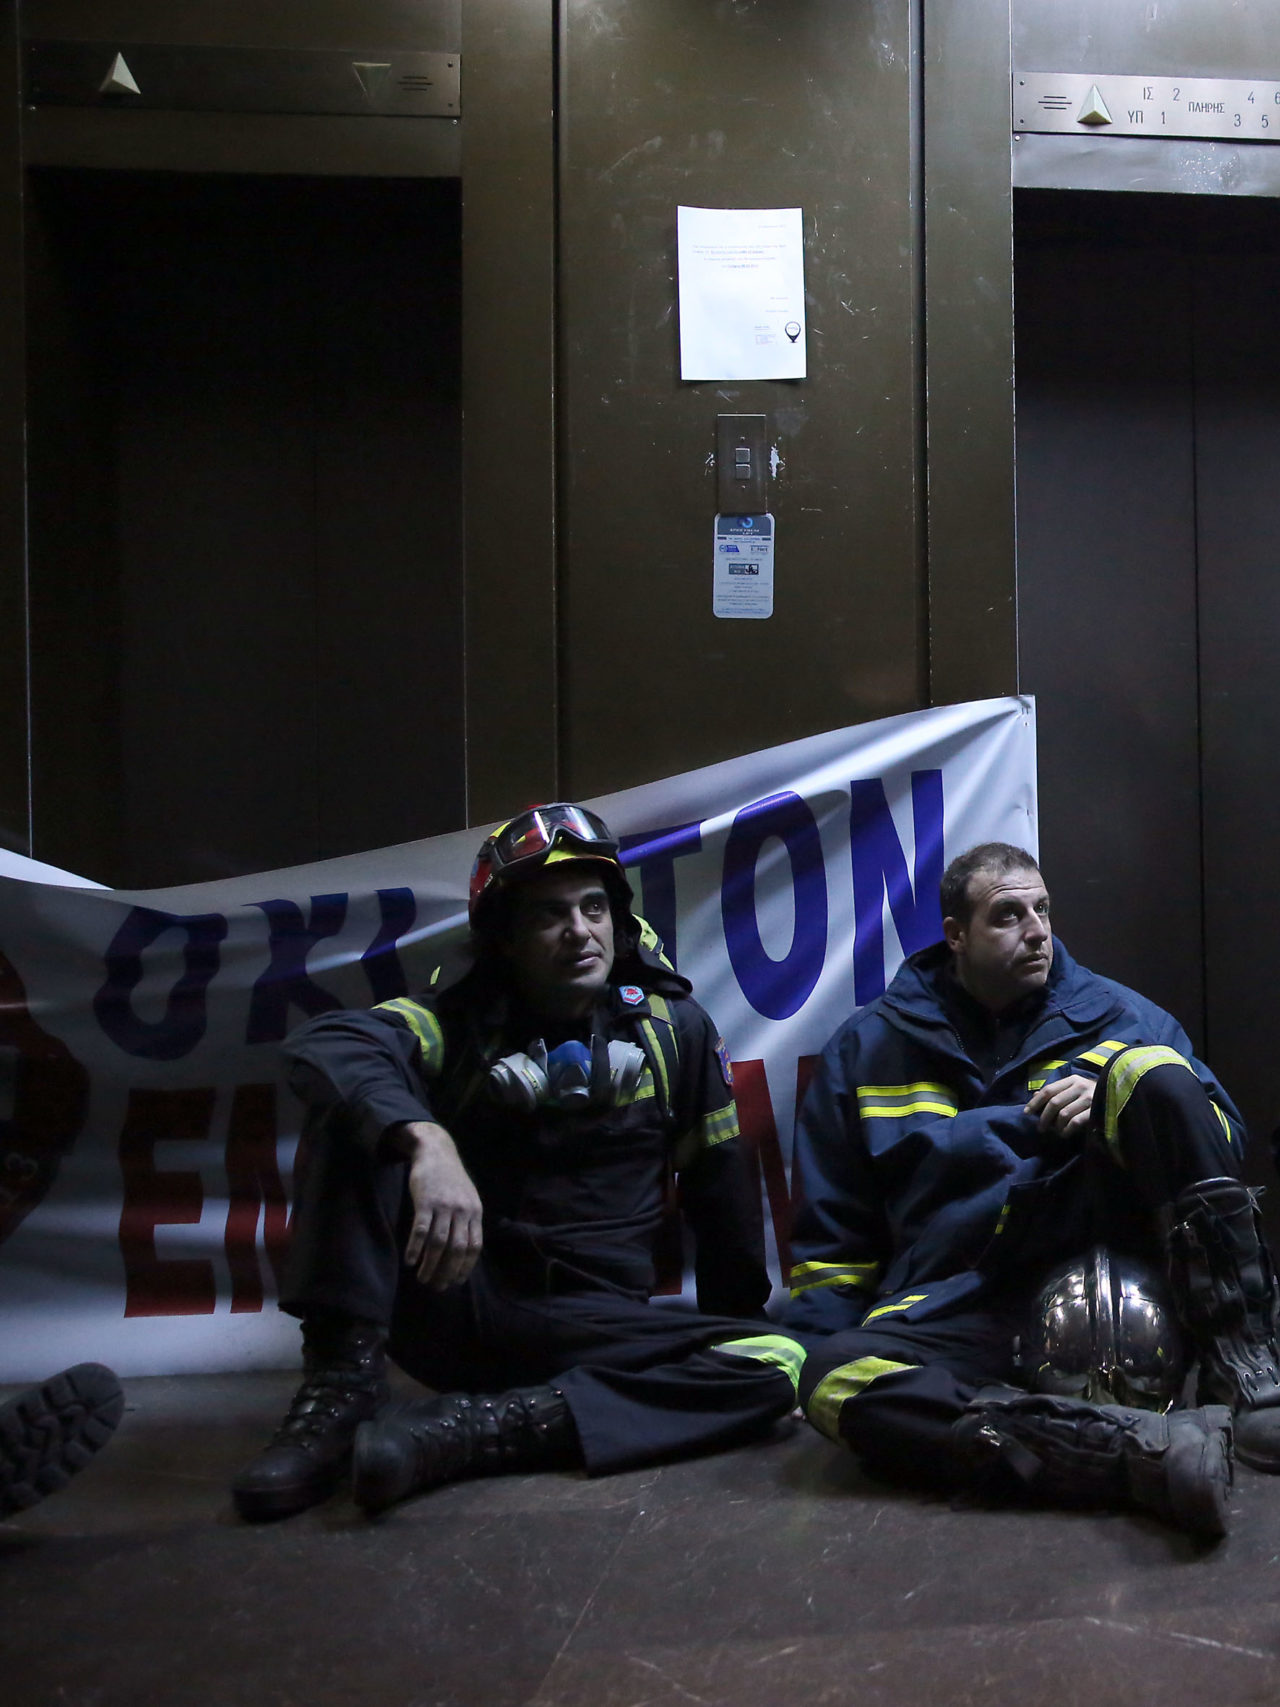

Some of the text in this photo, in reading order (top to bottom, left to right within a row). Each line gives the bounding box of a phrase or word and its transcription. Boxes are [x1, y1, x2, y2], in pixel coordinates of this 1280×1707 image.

[1173, 87, 1181, 101] 2
[1247, 91, 1255, 104] 4
[1188, 102, 1225, 114] ΠΛΗΡΗΣ
[1127, 110, 1167, 125] ΥΠ 1
[1233, 113, 1269, 129] 3 5
